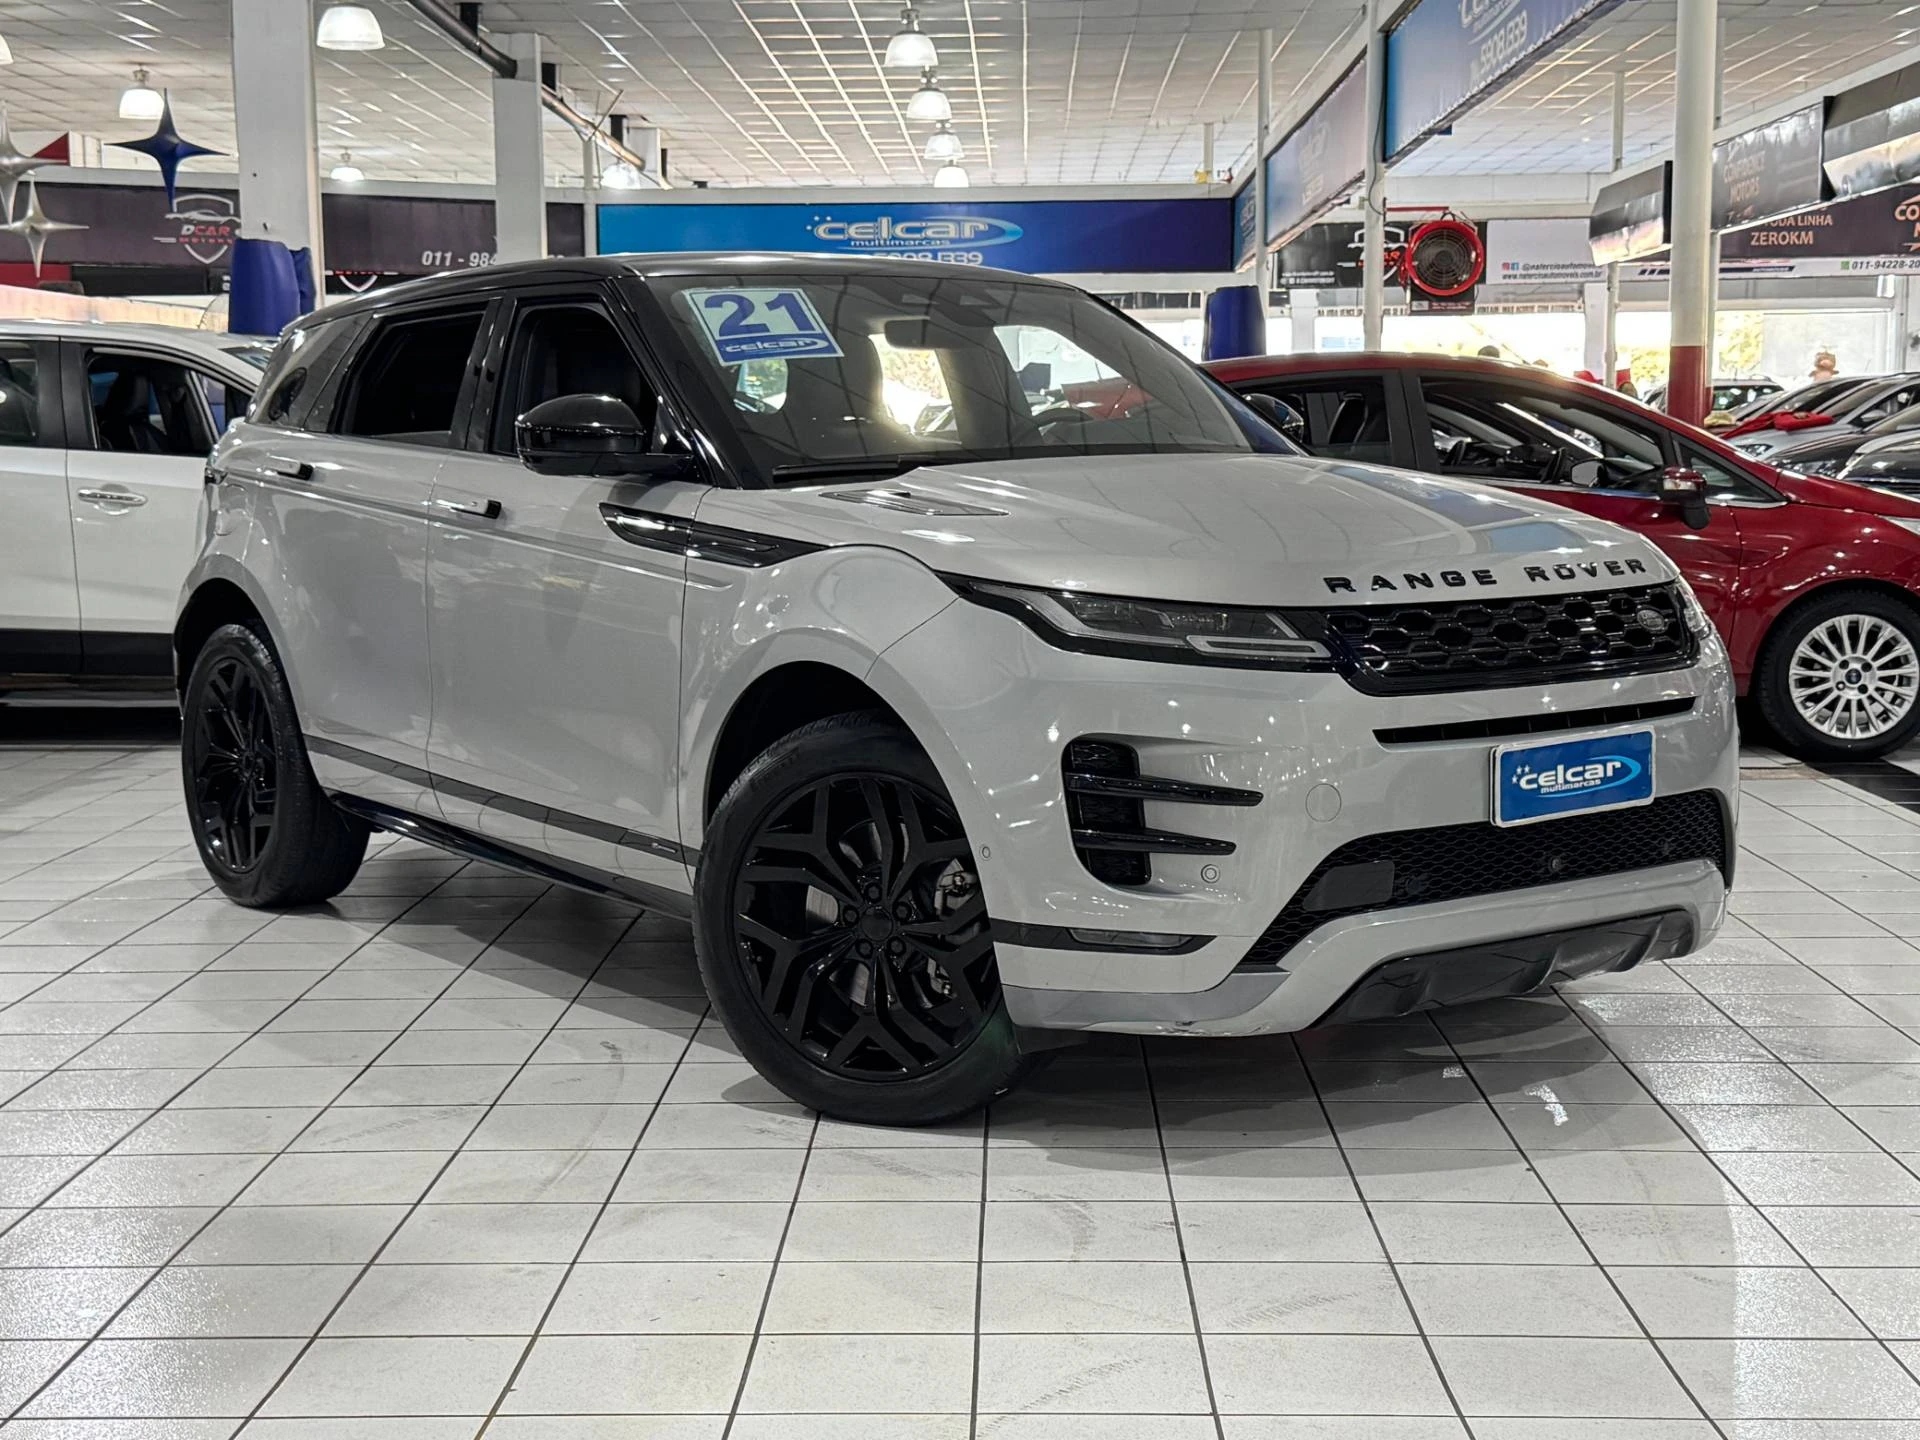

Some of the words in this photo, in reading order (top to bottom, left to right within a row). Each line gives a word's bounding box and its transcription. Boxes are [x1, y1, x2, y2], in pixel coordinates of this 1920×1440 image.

[1798, 214, 1833, 226] LINHA
[181, 224, 231, 236] DCAR
[814, 217, 989, 240] celcar
[1750, 230, 1814, 246] ZEROKM
[421, 250, 452, 266] 011
[704, 293, 817, 337] 21
[726, 340, 812, 353] celcar
[1323, 570, 1498, 593] RANGE
[1523, 558, 1646, 582] ROVER
[1520, 761, 1621, 790] celcar
[1541, 779, 1601, 794] multimarcas
